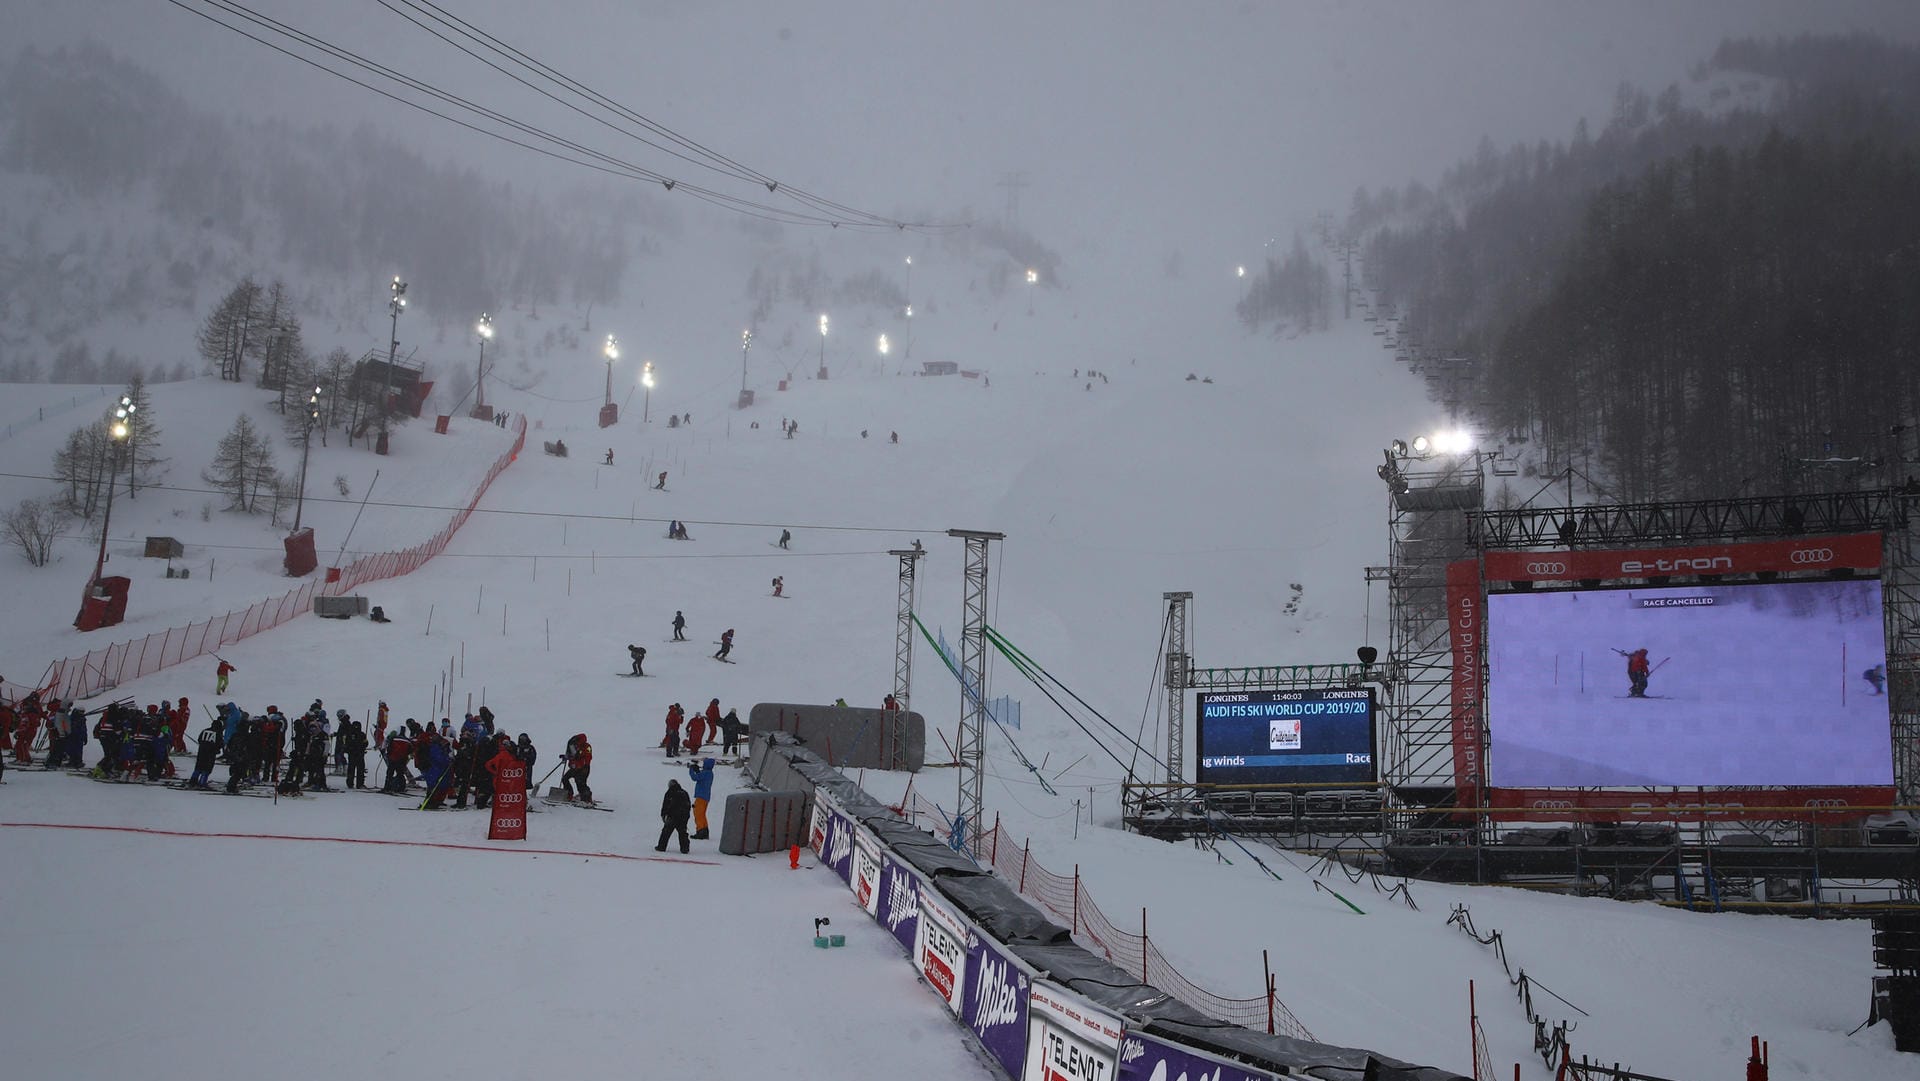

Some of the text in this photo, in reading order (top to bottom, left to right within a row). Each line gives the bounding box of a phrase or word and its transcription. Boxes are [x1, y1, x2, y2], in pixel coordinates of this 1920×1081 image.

[1621, 557, 1732, 573] e-tron
[1667, 598, 1713, 606] CANCELLED
[1459, 597, 1472, 628] Cup
[1461, 632, 1474, 684] World
[1204, 694, 1249, 703] LONGINES
[1272, 693, 1302, 701] 11:40:03
[1322, 690, 1369, 699] LONGINES
[1462, 684, 1474, 711] Ski
[1205, 701, 1366, 718] AUDI FIS SKI WORLD CUP 2019/20
[1464, 714, 1475, 740] FIS
[202, 730, 217, 743] ITA
[1213, 755, 1245, 767] winds
[974, 950, 1018, 1038] Milka
[1049, 1032, 1104, 1081] TELENOT
[1121, 1038, 1145, 1064] Milka
